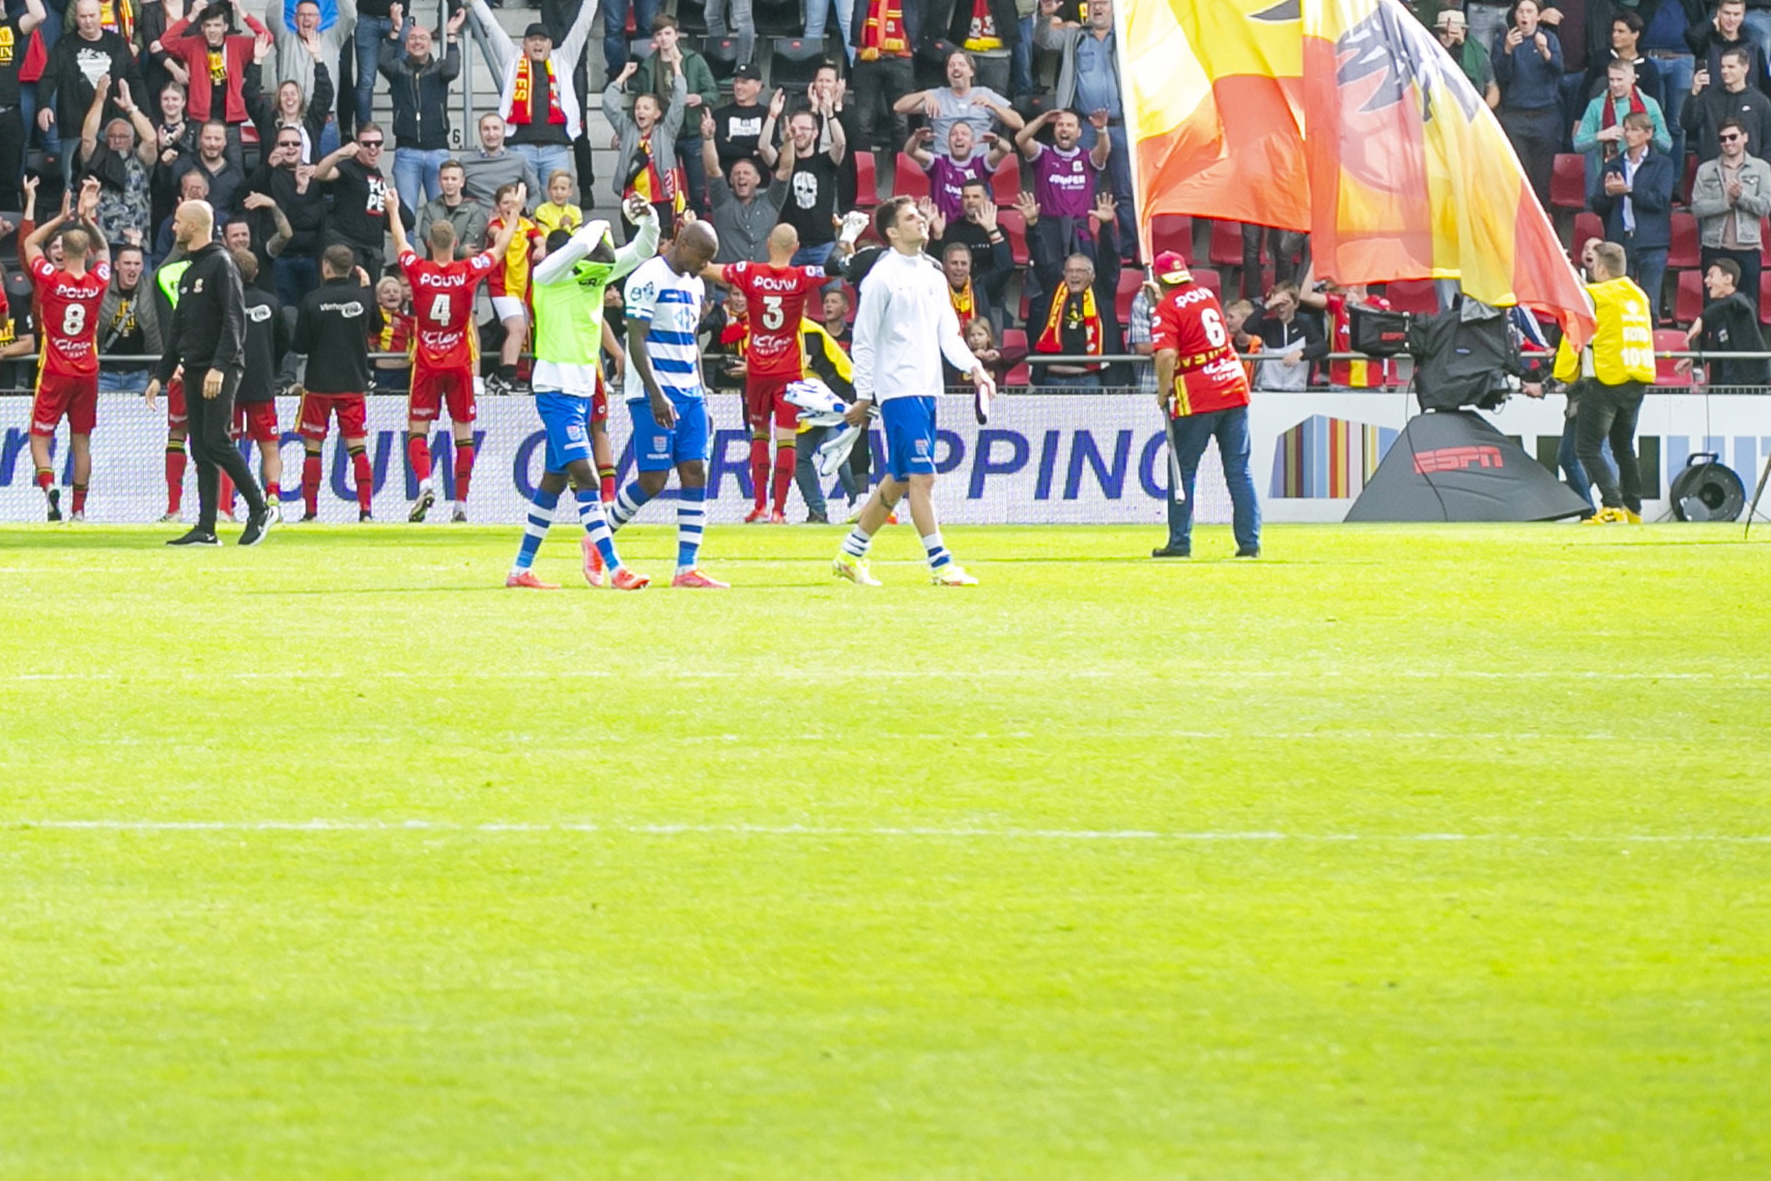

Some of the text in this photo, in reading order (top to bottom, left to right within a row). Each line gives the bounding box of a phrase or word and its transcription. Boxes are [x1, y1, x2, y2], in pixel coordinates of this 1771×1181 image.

[452, 128, 462, 144] 6
[1048, 174, 1086, 185] JUMPER
[56, 284, 100, 300] POUW
[420, 273, 467, 288] POUW
[753, 274, 797, 291] POUW
[62, 302, 86, 337] 8
[429, 293, 451, 327] 4
[762, 295, 785, 330] 3
[1202, 307, 1226, 348] 6
[218, 429, 486, 502] OUW
[1413, 446, 1505, 475] ESPN
